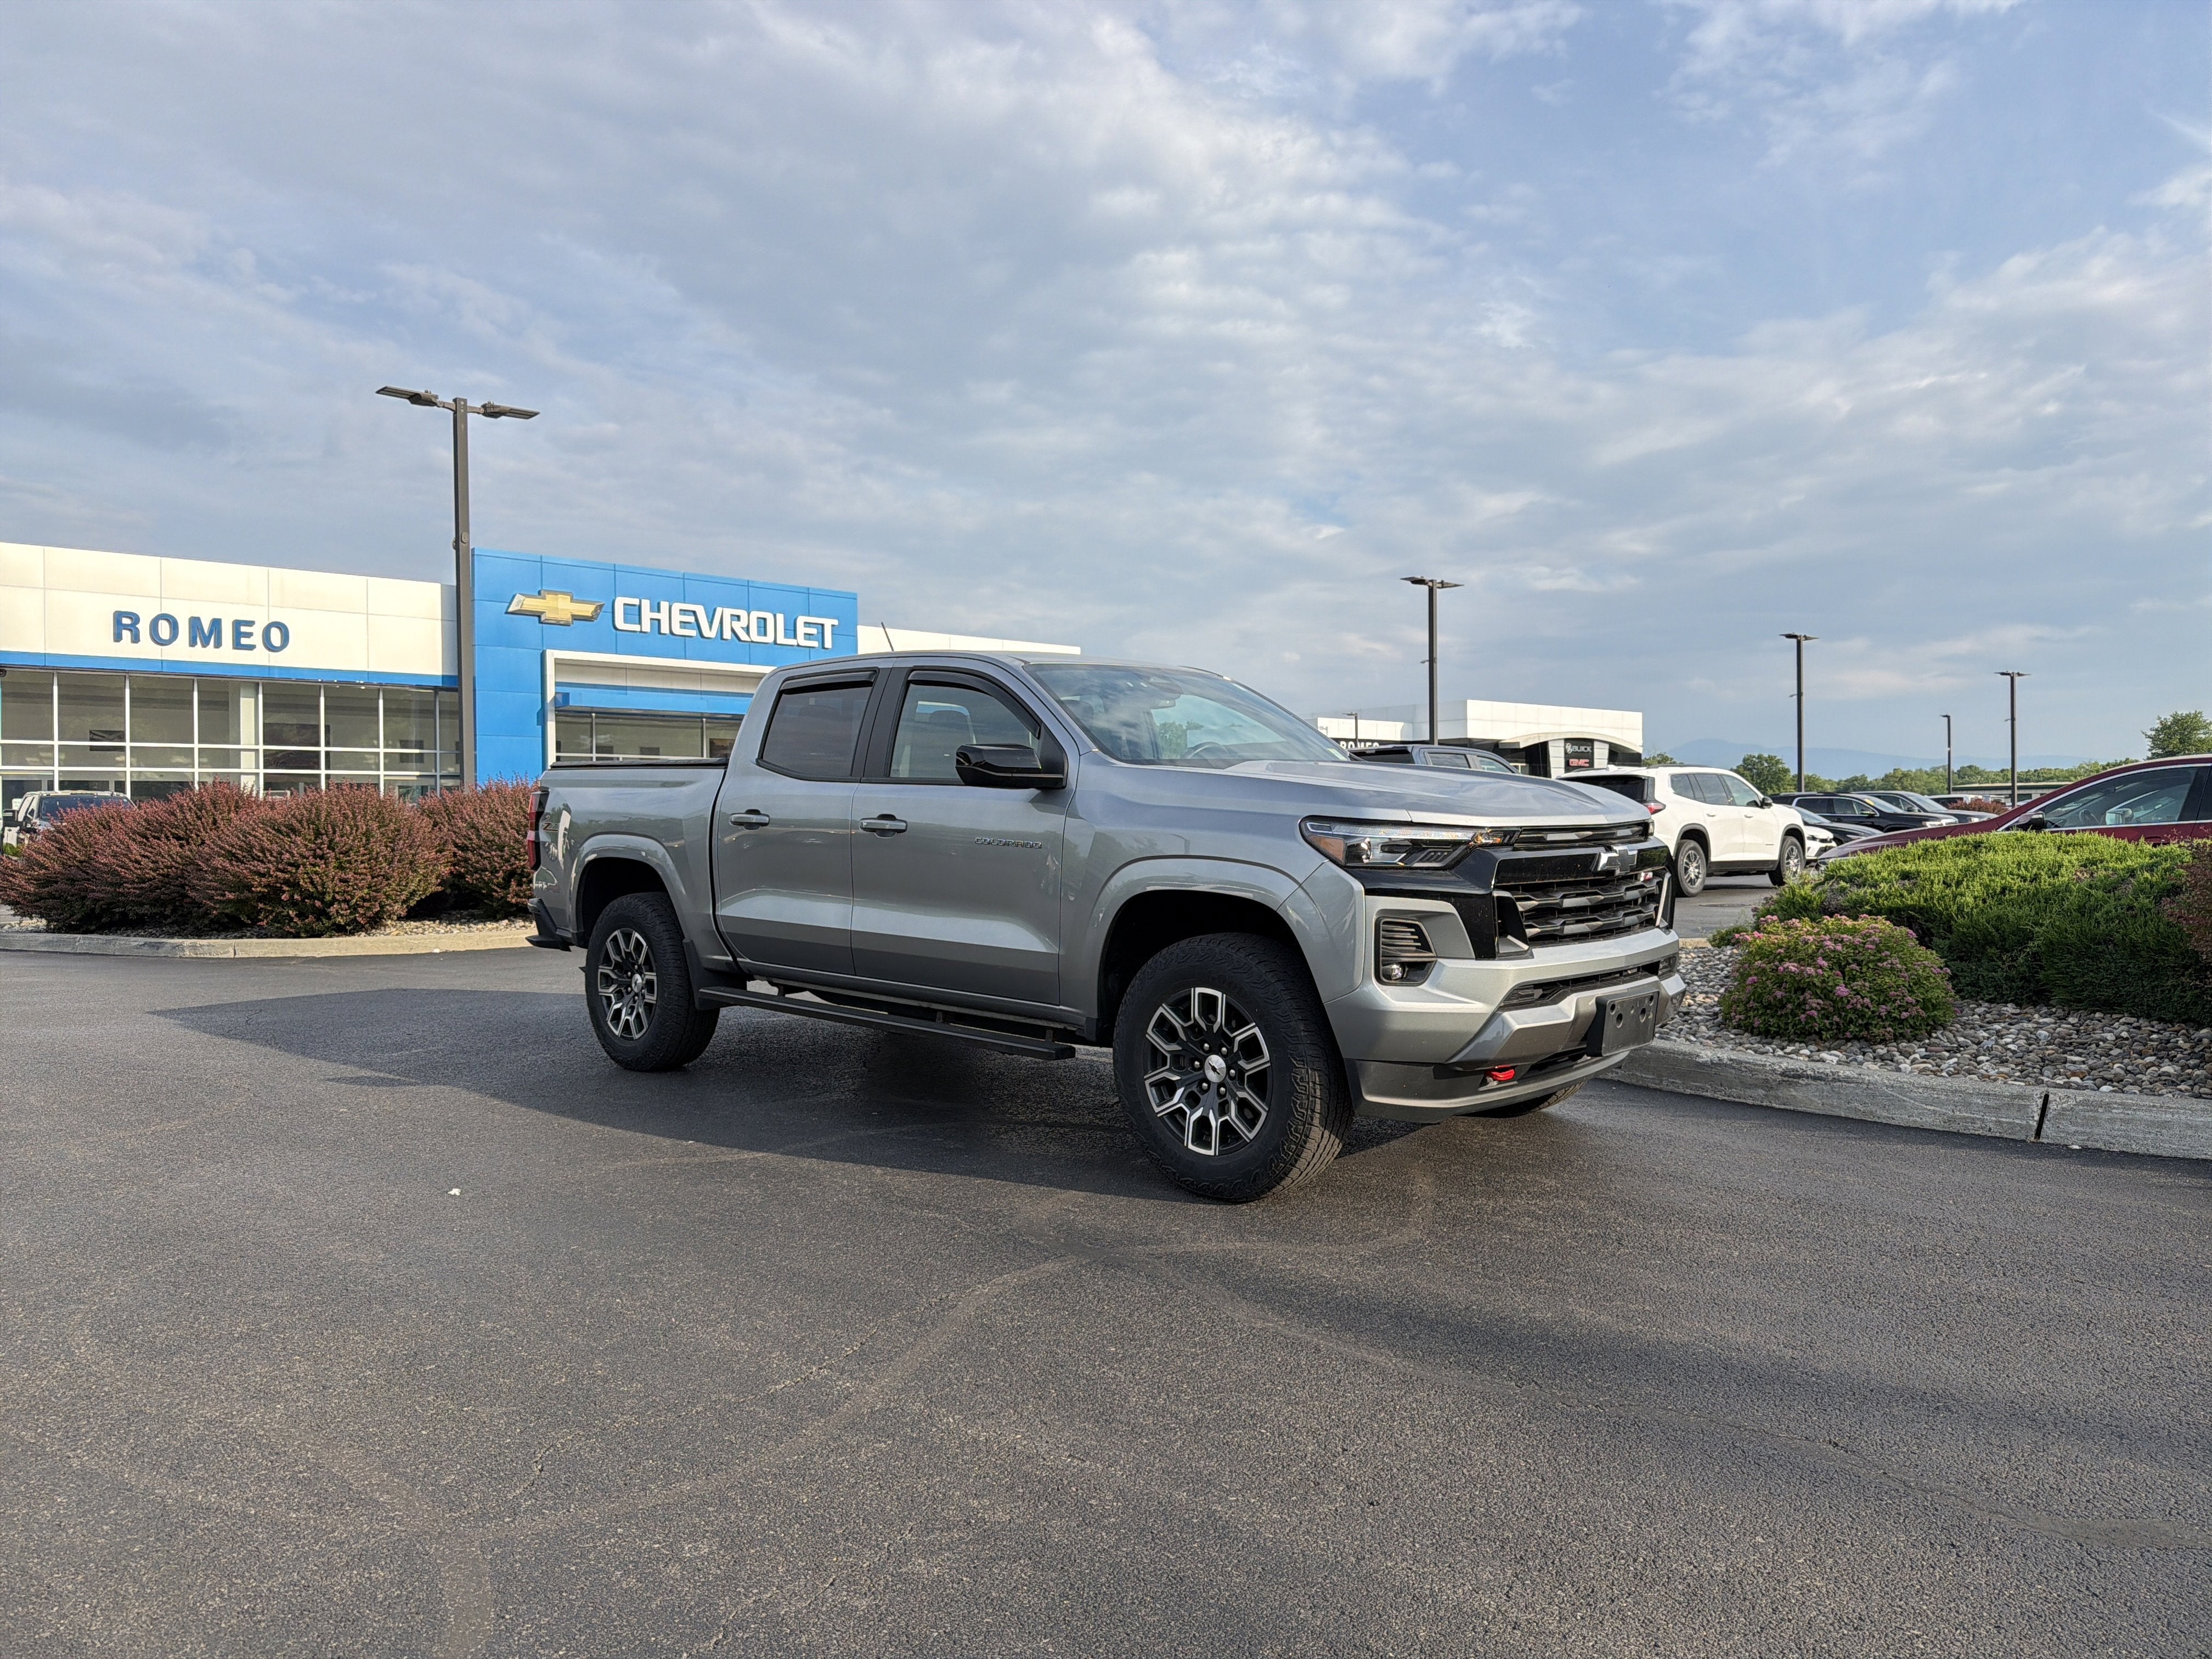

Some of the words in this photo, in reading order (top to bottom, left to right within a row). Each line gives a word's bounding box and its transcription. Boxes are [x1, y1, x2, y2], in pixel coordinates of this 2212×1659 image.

[112, 611, 290, 653] ROMEO
[613, 596, 839, 650] CHEVROLET
[974, 837, 1042, 849] COLORADO
